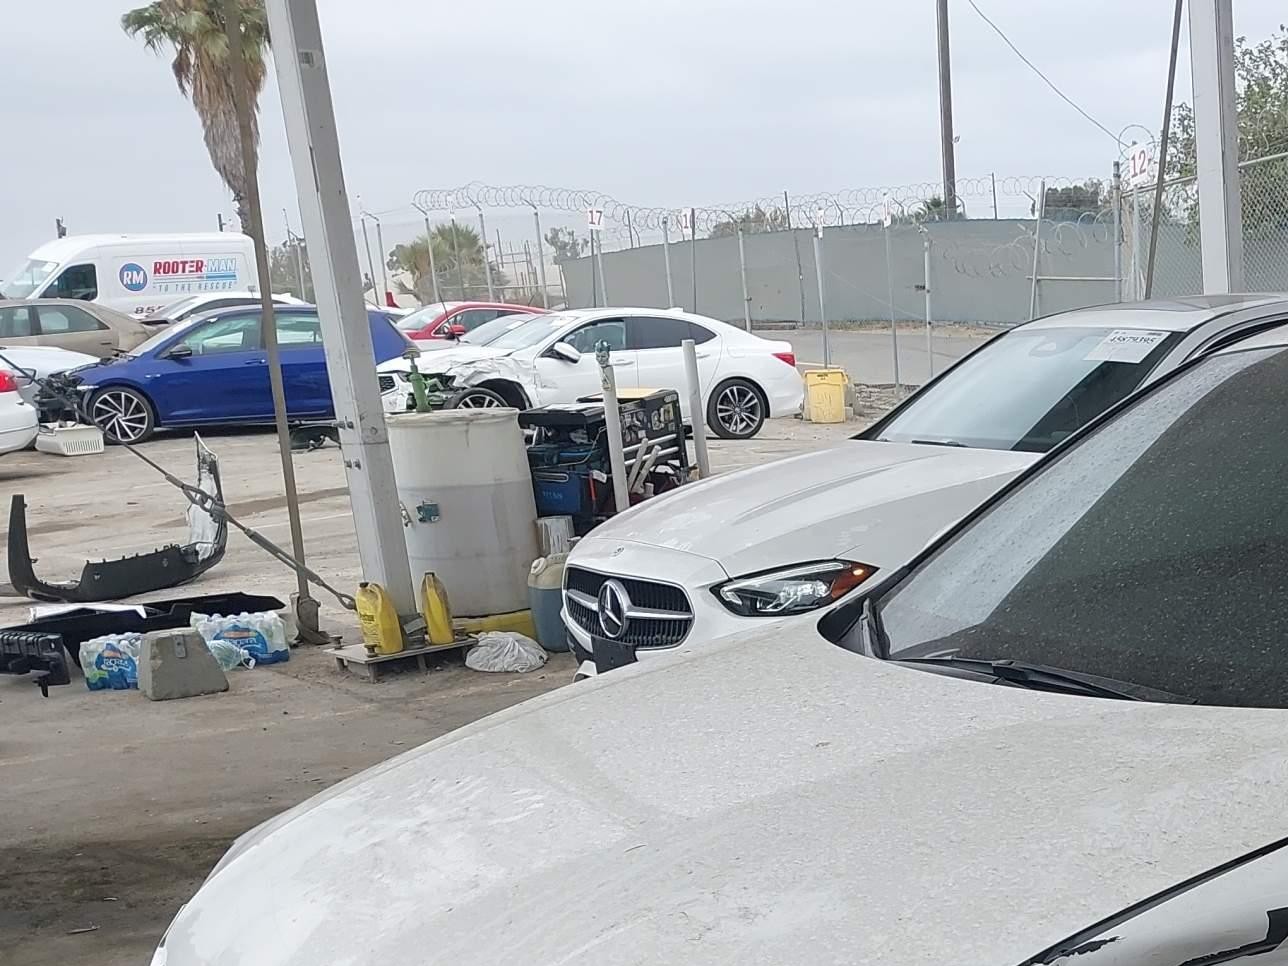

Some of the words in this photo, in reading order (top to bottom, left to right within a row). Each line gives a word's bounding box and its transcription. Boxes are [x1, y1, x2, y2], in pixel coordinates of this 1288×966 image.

[1131, 150, 1147, 178] 12
[588, 210, 603, 225] 17
[123, 270, 144, 286] RM
[175, 283, 192, 293] THE
